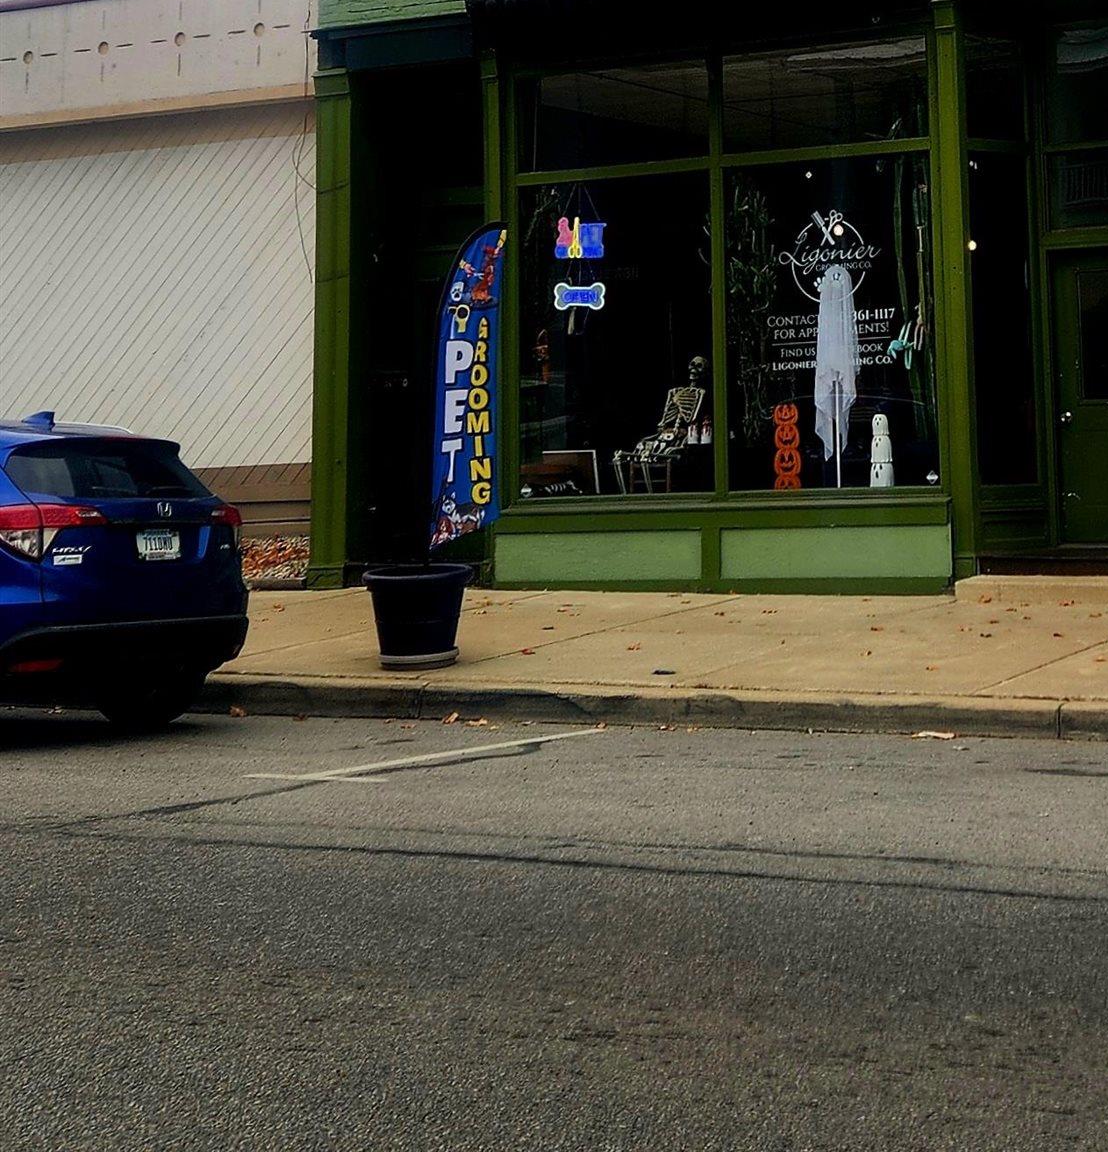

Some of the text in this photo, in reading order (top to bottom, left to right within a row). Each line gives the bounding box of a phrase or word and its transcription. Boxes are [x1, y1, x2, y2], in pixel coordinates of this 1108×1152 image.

[779, 232, 881, 275] Ligonier
[774, 328, 796, 340] FOR
[772, 360, 818, 371] LIGONIER
[875, 355, 893, 365] CO.
[781, 347, 803, 358] FIND
[805, 347, 816, 356] US
[441, 340, 474, 483] PET
[467, 317, 492, 505] GROOMING
